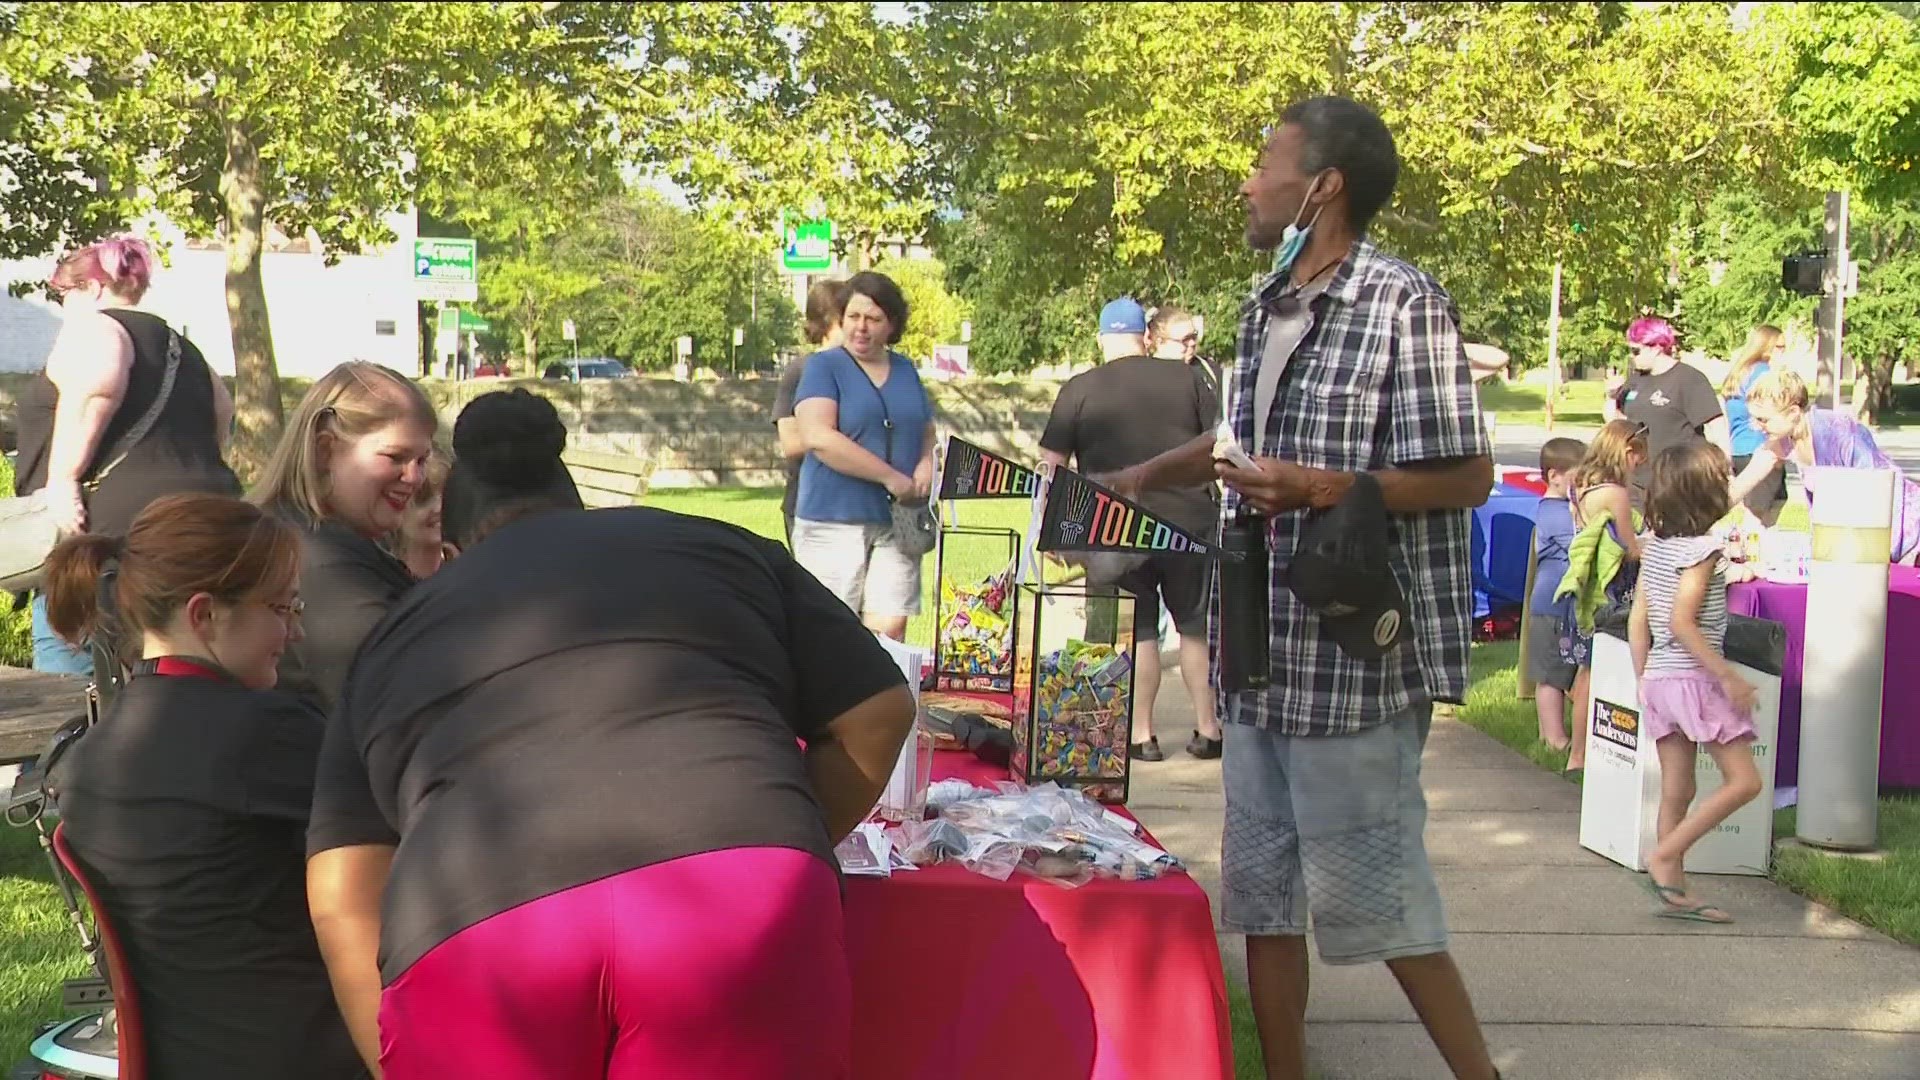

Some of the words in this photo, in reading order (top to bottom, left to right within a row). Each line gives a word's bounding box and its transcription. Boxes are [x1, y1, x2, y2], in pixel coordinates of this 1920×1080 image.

[1087, 491, 1187, 551] TOLEDO
[1596, 701, 1611, 721] The
[1594, 718, 1637, 748] Andersons
